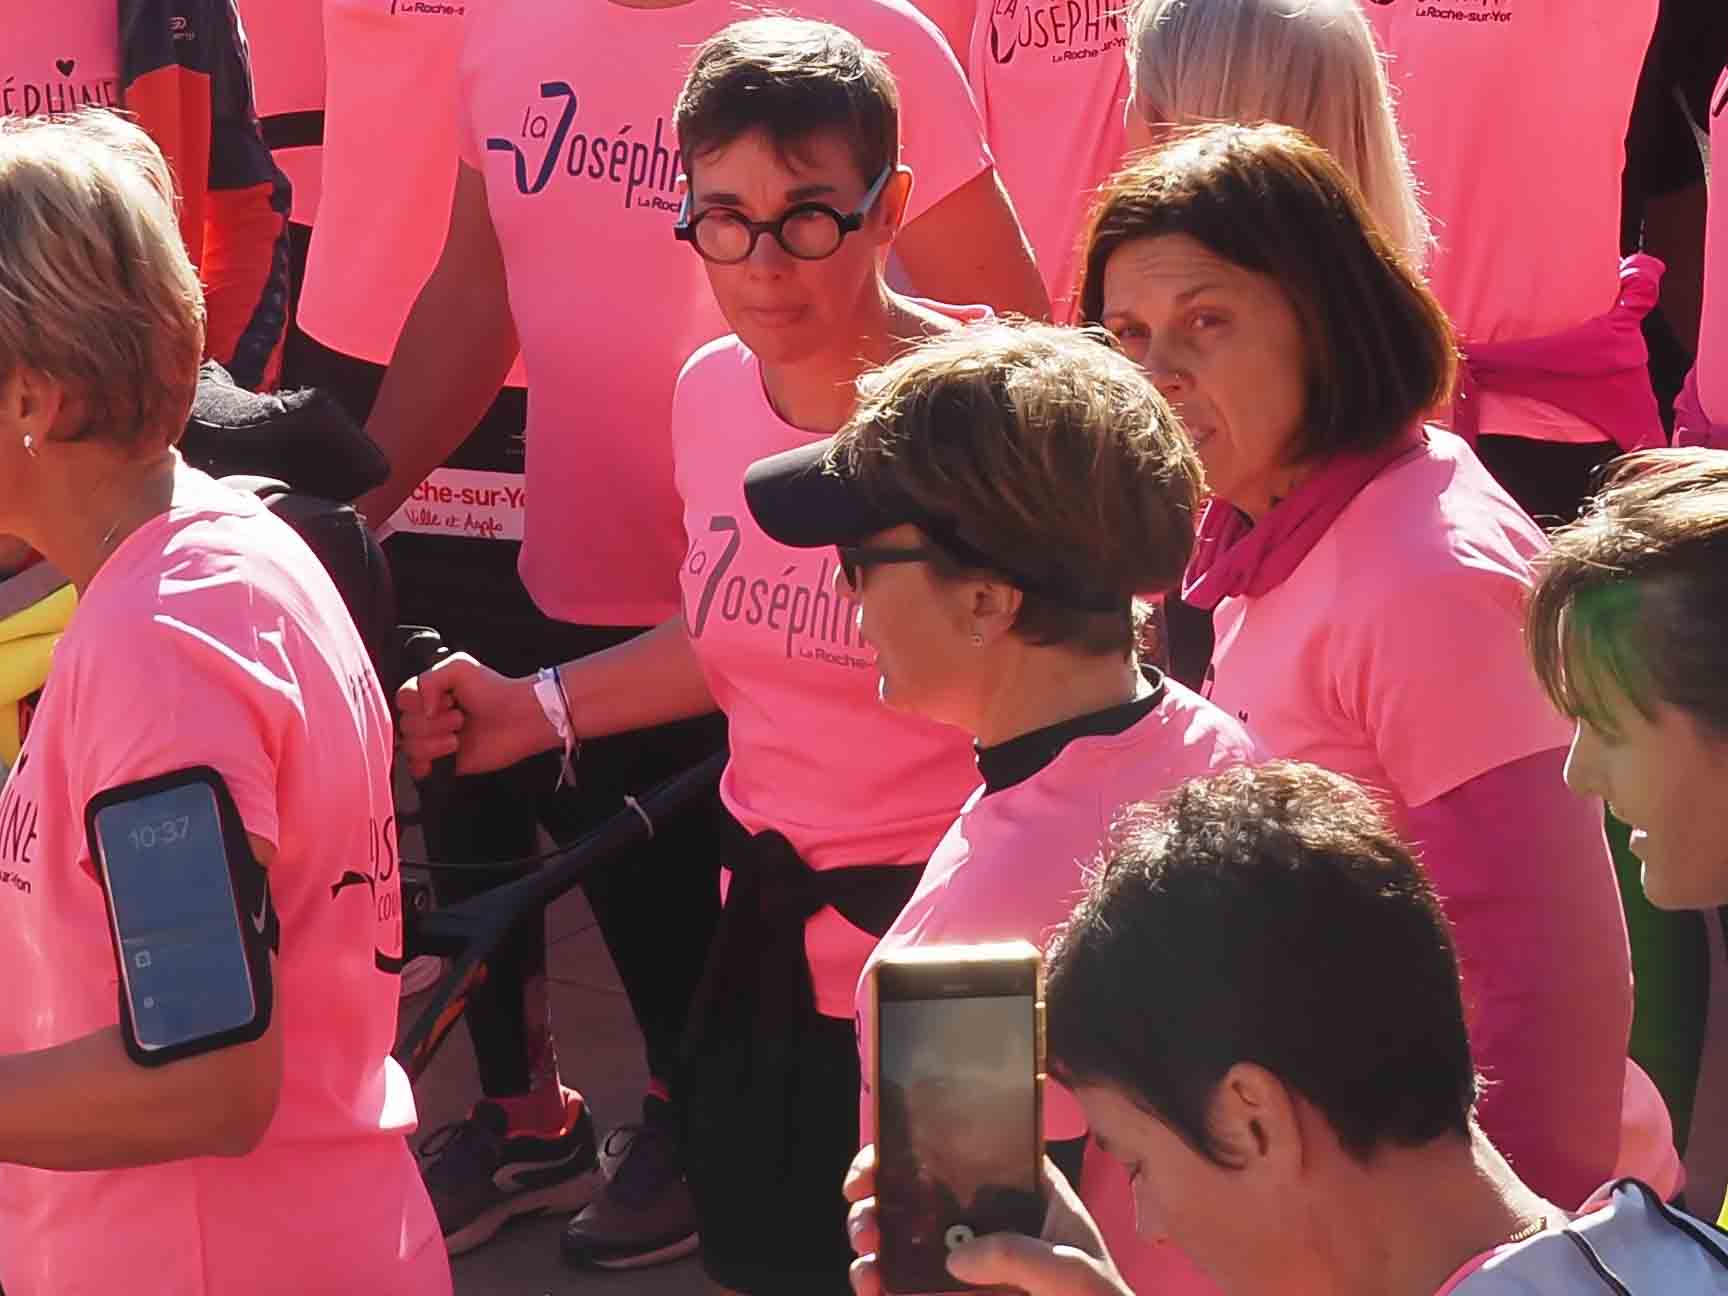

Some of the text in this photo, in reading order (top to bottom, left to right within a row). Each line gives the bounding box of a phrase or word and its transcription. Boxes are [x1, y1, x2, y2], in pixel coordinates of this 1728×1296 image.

[522, 106, 548, 138] la
[404, 507, 441, 526] Ville
[128, 816, 190, 850] 10:37
